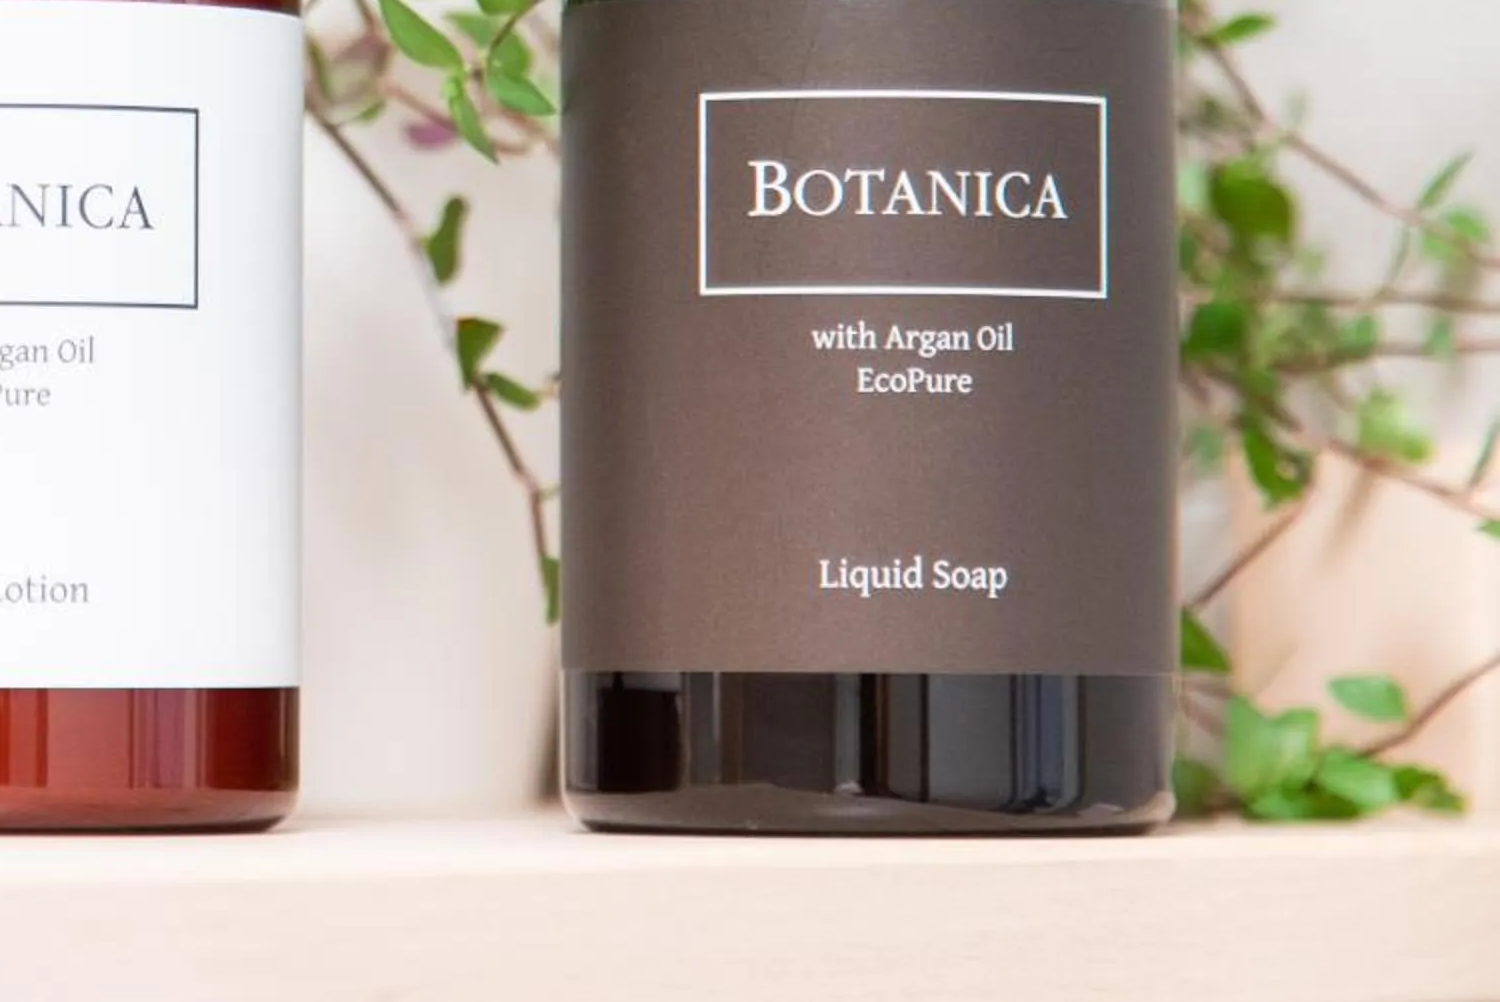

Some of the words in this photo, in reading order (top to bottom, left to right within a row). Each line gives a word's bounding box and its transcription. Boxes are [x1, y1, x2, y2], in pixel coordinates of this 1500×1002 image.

[747, 159, 1068, 219] BOTANICA
[57, 334, 95, 364] Oil
[811, 319, 878, 350] with
[883, 324, 971, 359] Argan
[976, 321, 1013, 351] Oil
[856, 366, 973, 394] EcoPure
[818, 554, 924, 599] Liquid
[931, 559, 1008, 599] Soap
